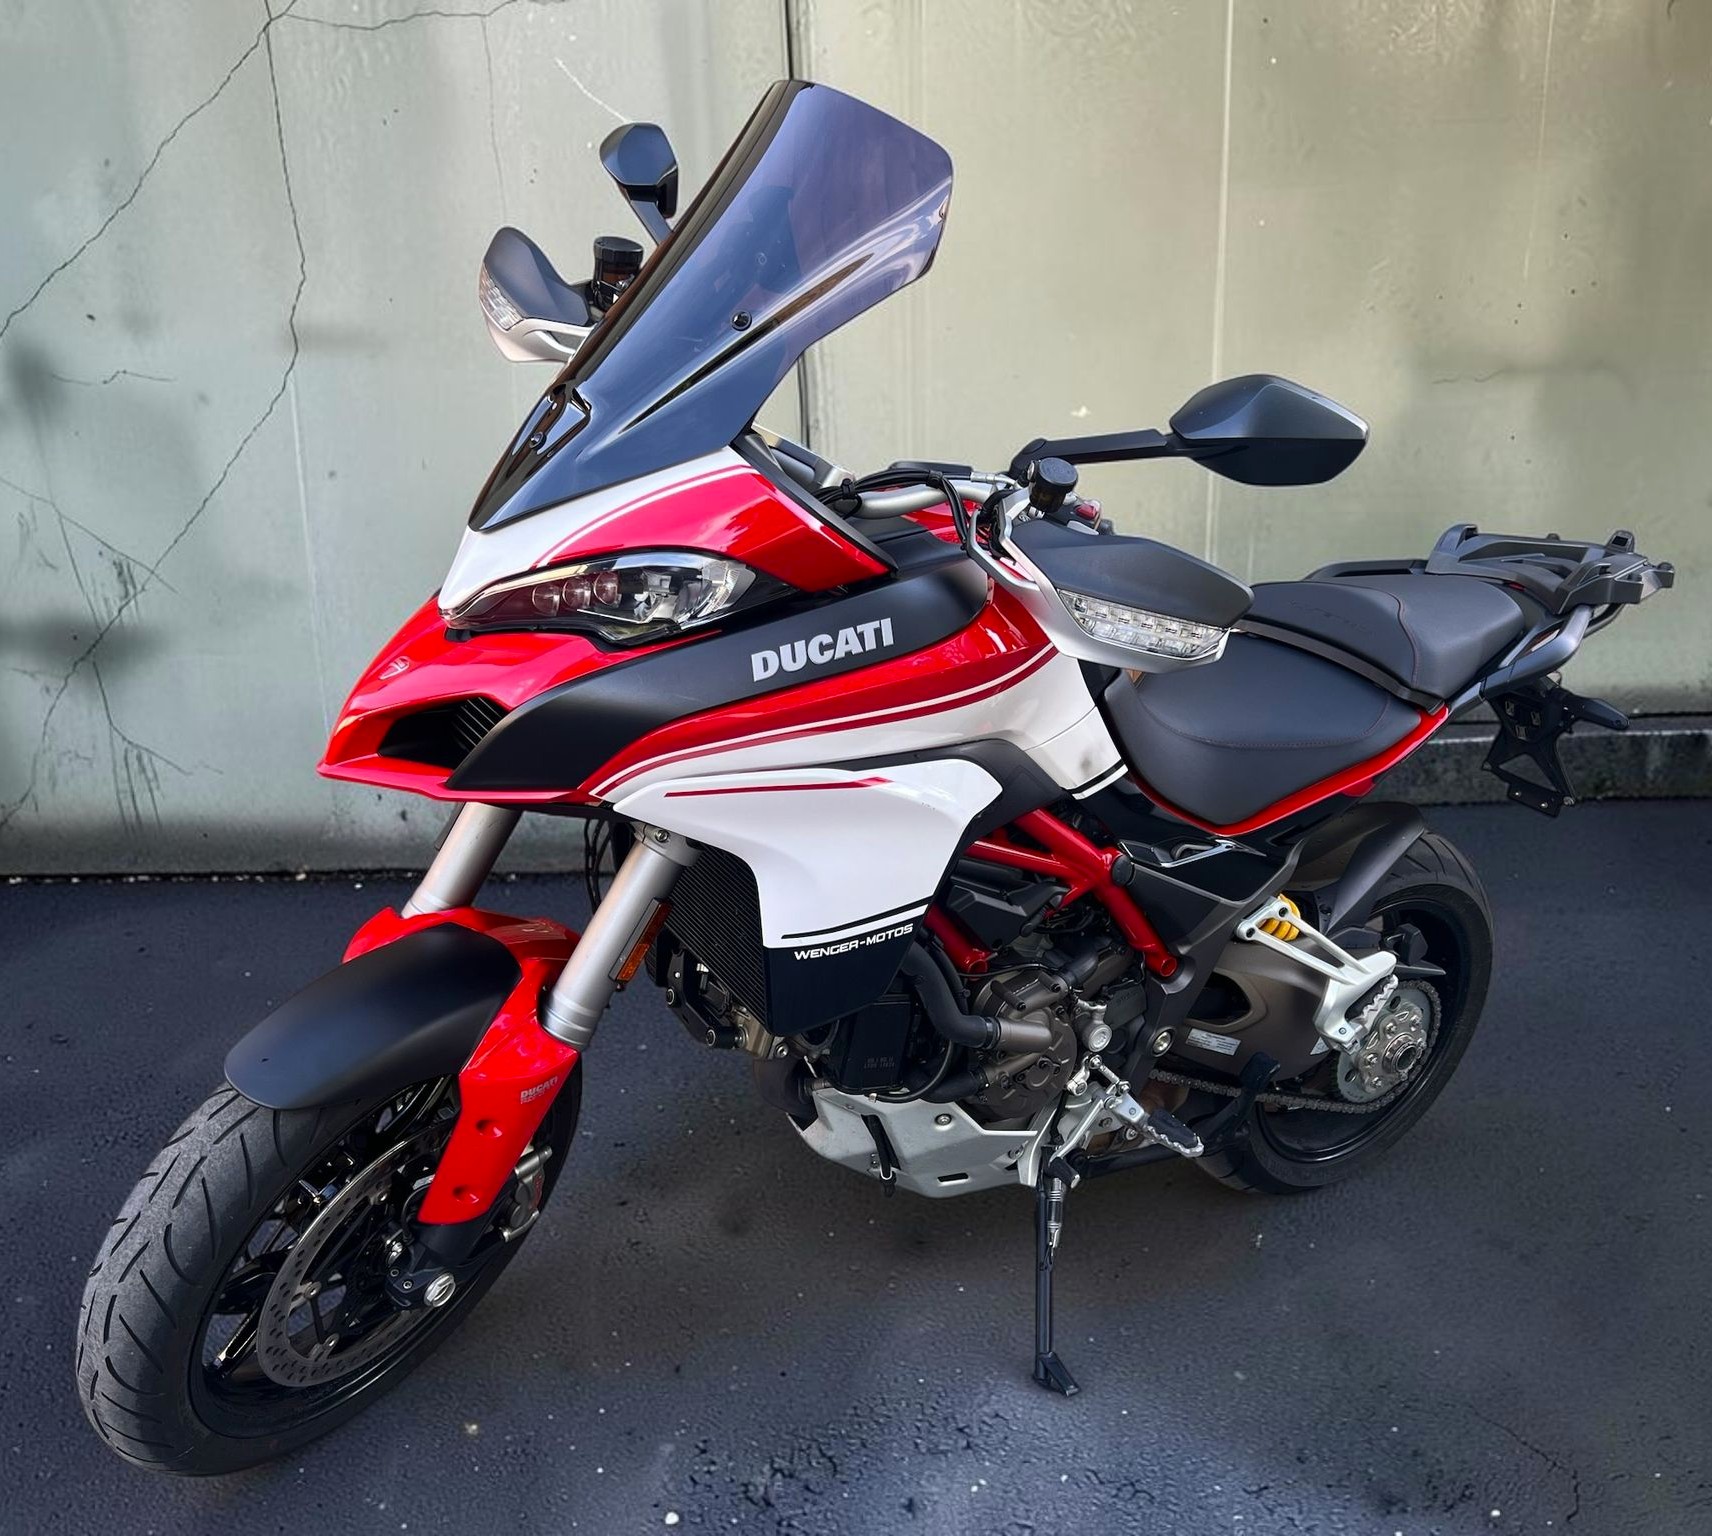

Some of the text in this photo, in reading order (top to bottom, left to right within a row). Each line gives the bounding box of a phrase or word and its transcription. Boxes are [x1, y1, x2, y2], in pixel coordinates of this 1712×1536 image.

[751, 617, 894, 682] DUCATI
[794, 923, 914, 960] WENGER-MOTOS
[520, 1075, 558, 1098] DUCATI
